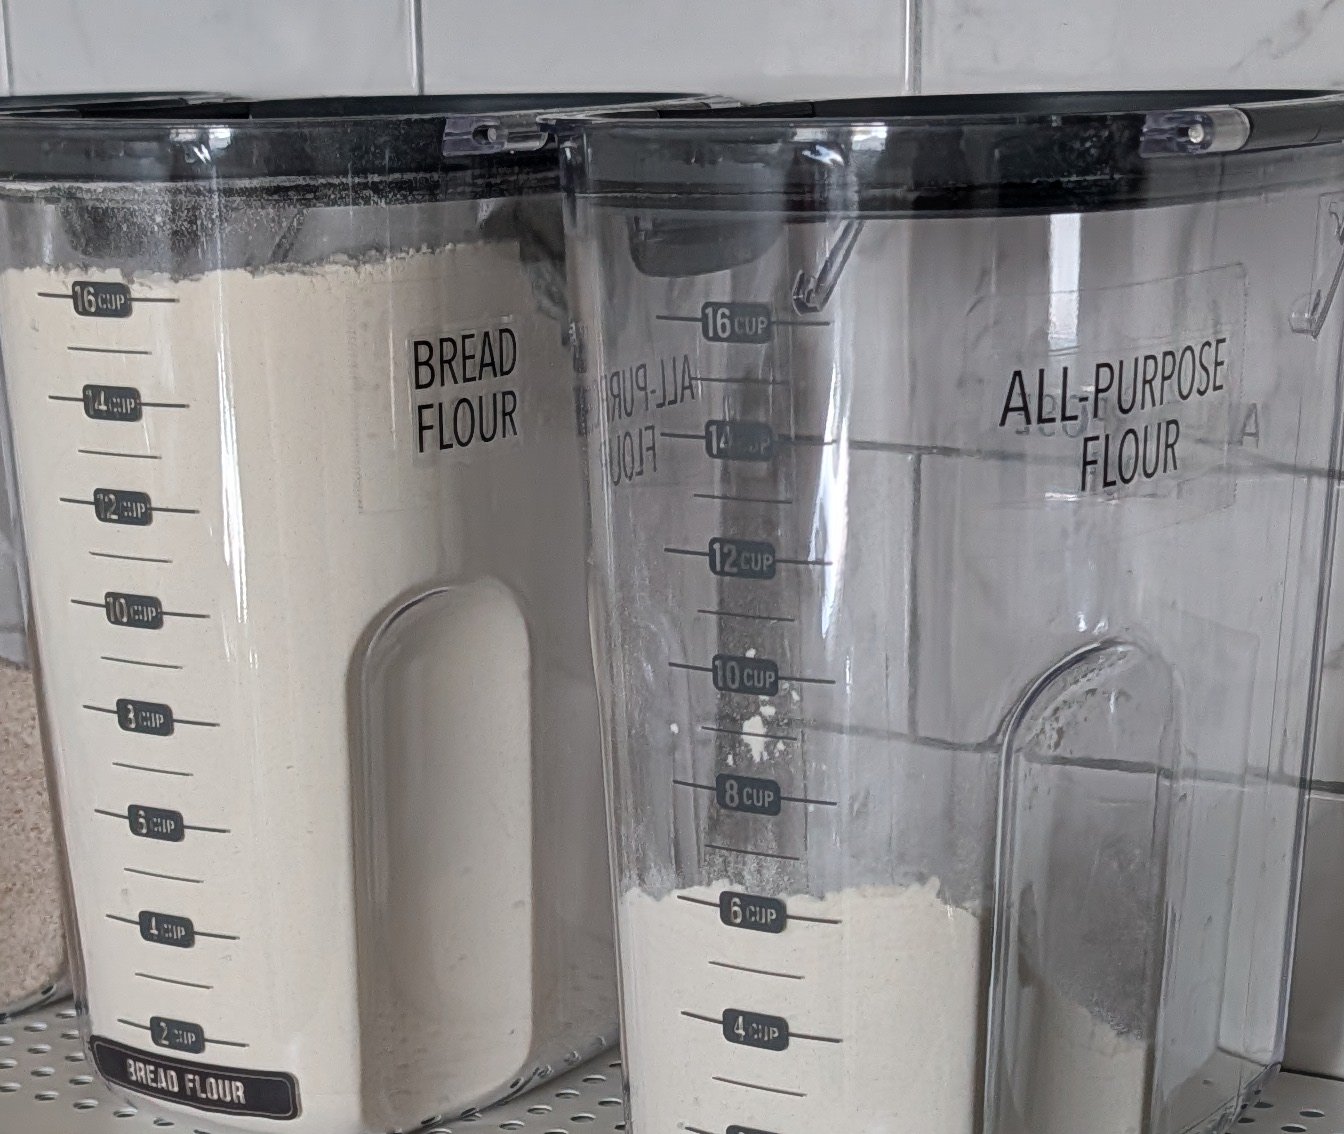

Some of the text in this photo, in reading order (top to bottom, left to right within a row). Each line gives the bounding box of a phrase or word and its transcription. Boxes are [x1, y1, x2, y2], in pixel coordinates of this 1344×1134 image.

[413, 328, 517, 390] BREAD
[999, 338, 1227, 427] ALL-PURPOSE
[417, 390, 518, 453] FLOUR
[1080, 419, 1181, 492] FLOUR
[126, 1059, 246, 1104] BREAD FLOUR
